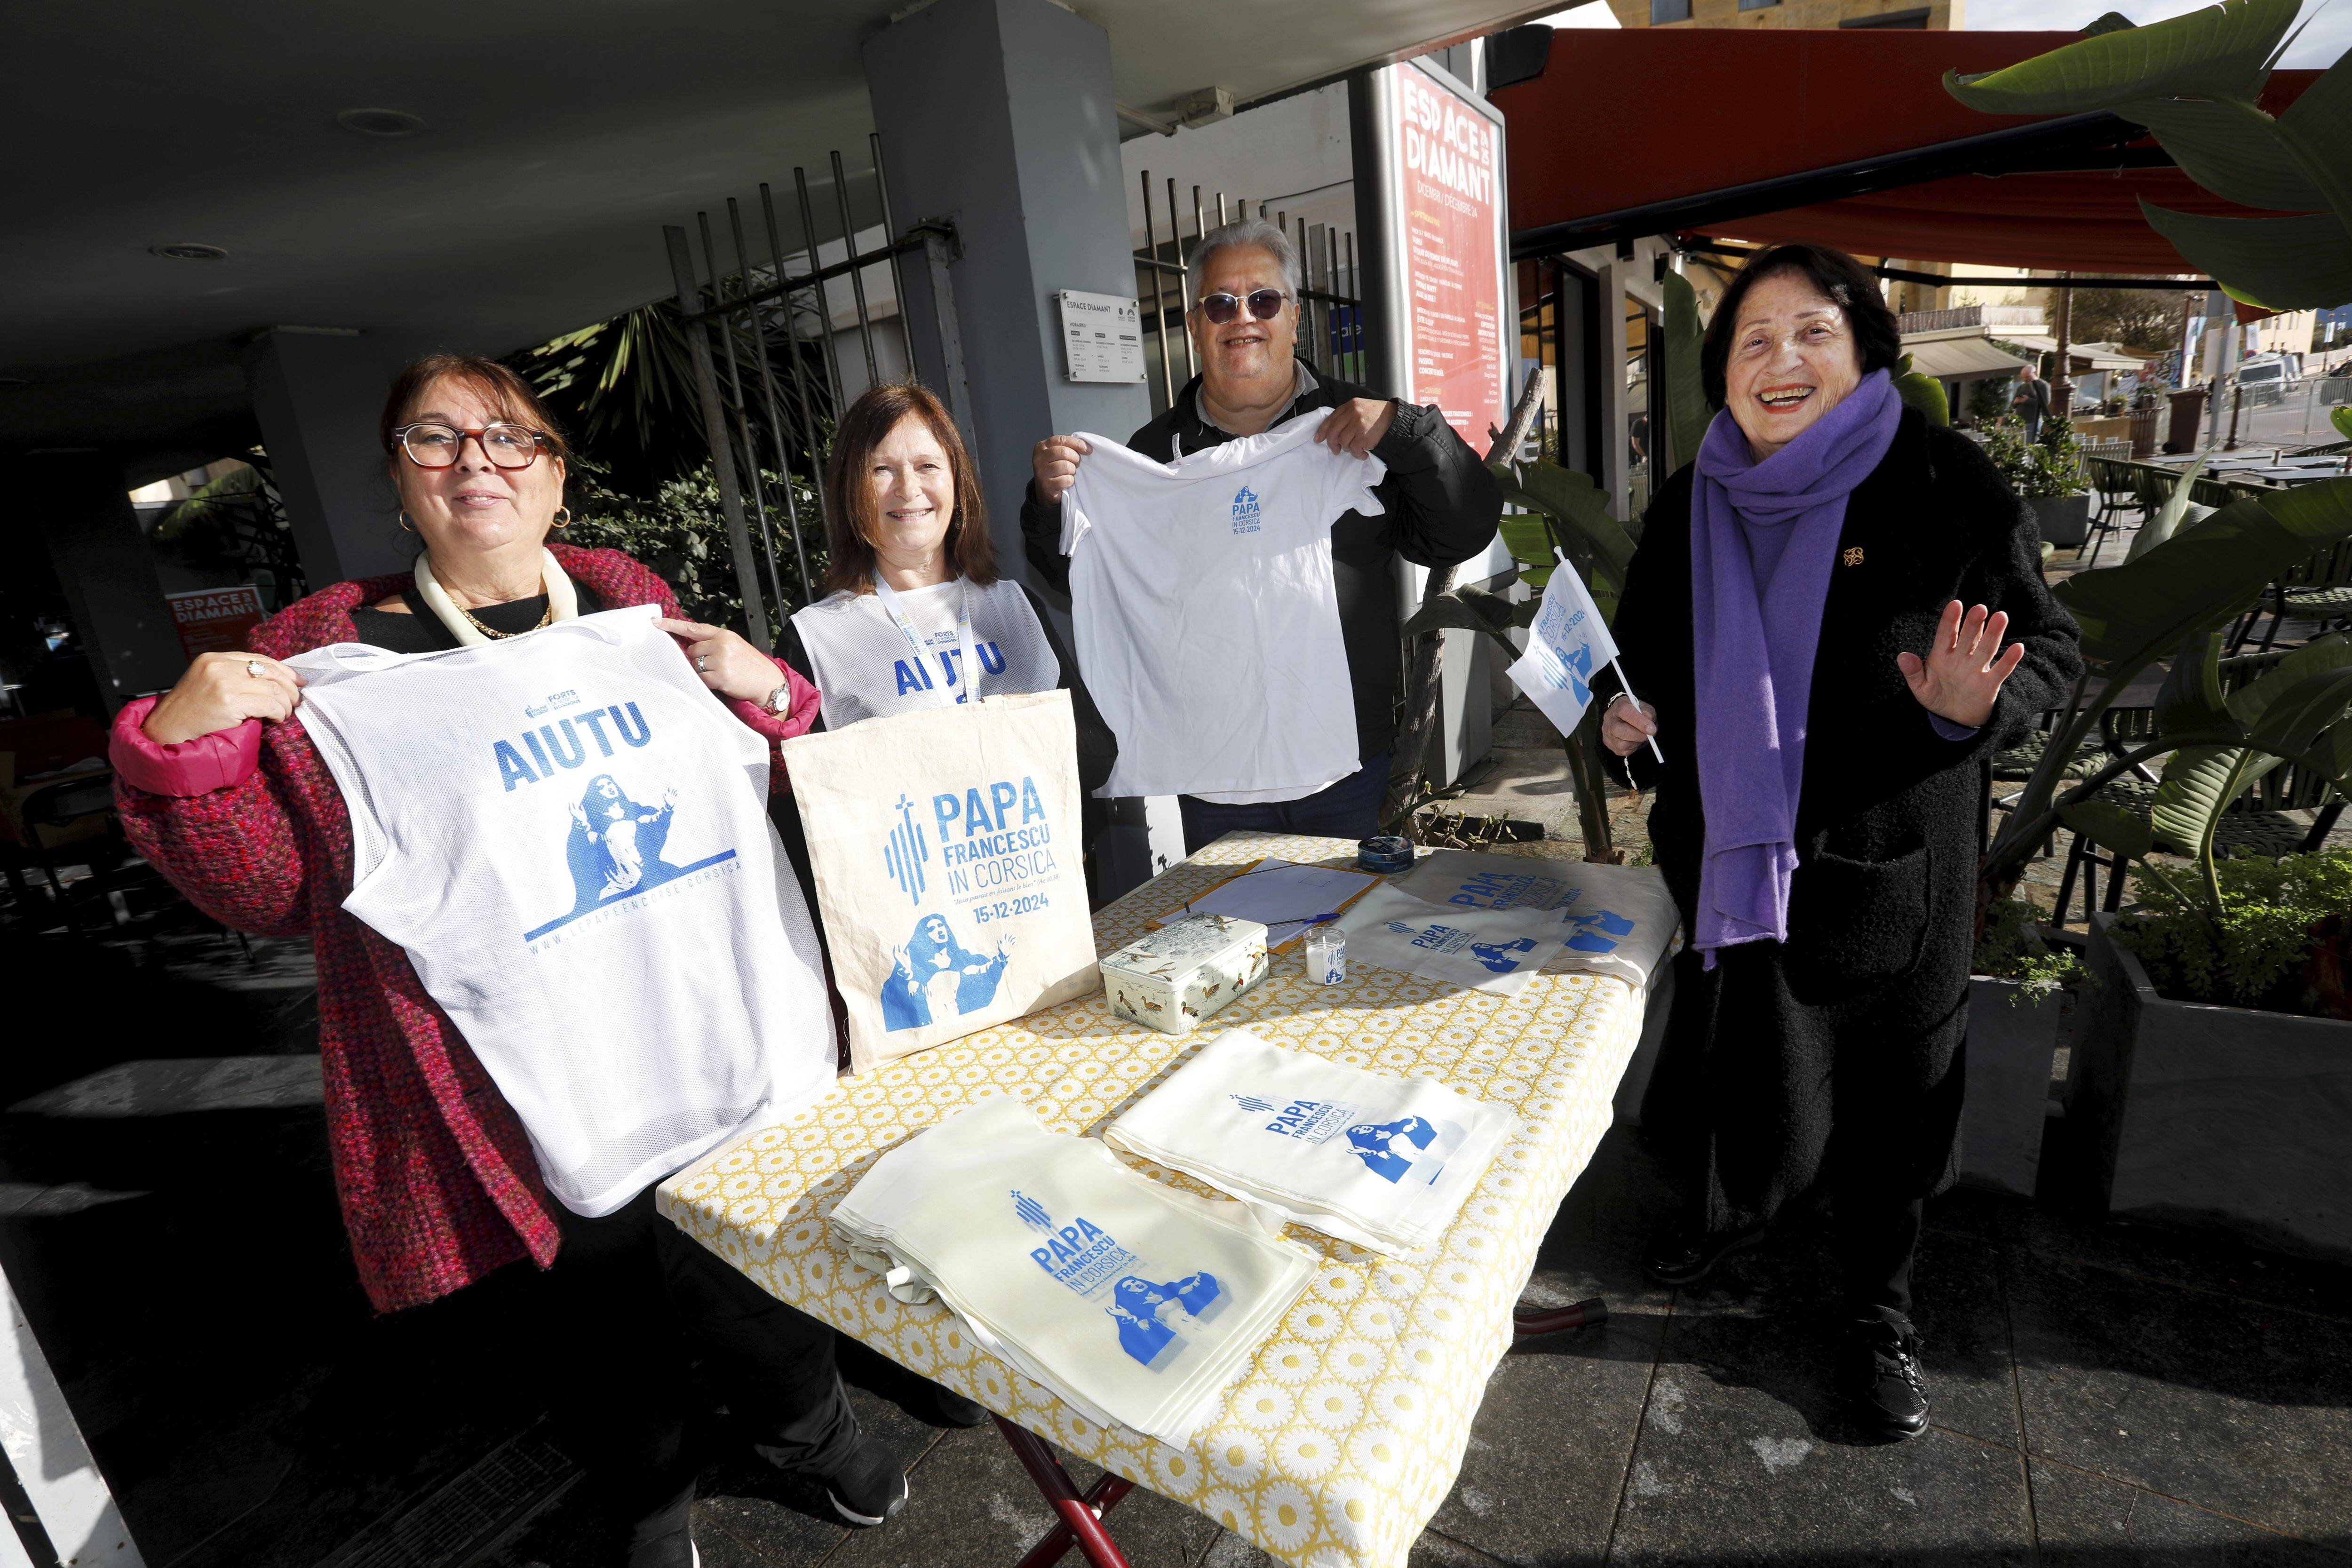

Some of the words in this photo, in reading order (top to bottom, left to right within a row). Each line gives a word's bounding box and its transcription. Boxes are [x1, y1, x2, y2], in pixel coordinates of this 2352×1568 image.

[1403, 79, 1480, 159] ESPACE
[1406, 126, 1490, 205] DIAMANT
[1067, 301, 1087, 310] ESPACE
[1087, 303, 1111, 313] DIAMANT
[1232, 502, 1260, 516] PAPA
[1232, 512, 1260, 521] FRANCESCU
[1239, 518, 1261, 526] CORSICA
[172, 593, 240, 612] ESPACE
[1543, 601, 1564, 645] CORSICA
[493, 700, 652, 792] AIUTU
[932, 776, 1046, 844] PAPA
[943, 823, 1050, 868] FRANCESCU
[947, 868, 969, 895] IN
[974, 848, 1057, 888] CORSICA
[1410, 924, 1451, 949] PAPA
[1430, 929, 1460, 950] FRANCESCU
[1450, 932, 1472, 948] CORSICA
[1265, 1100, 1321, 1135] PAPA
[1291, 1104, 1333, 1139] FRANCESCU
[1304, 1135, 1321, 1144] IN
[1313, 1109, 1350, 1137] CORSICA
[1030, 1217, 1104, 1274] PAPA
[1054, 1235, 1116, 1282] FRANCESCU
[1066, 1279, 1086, 1292] IN
[1081, 1247, 1131, 1283] CORSICA
